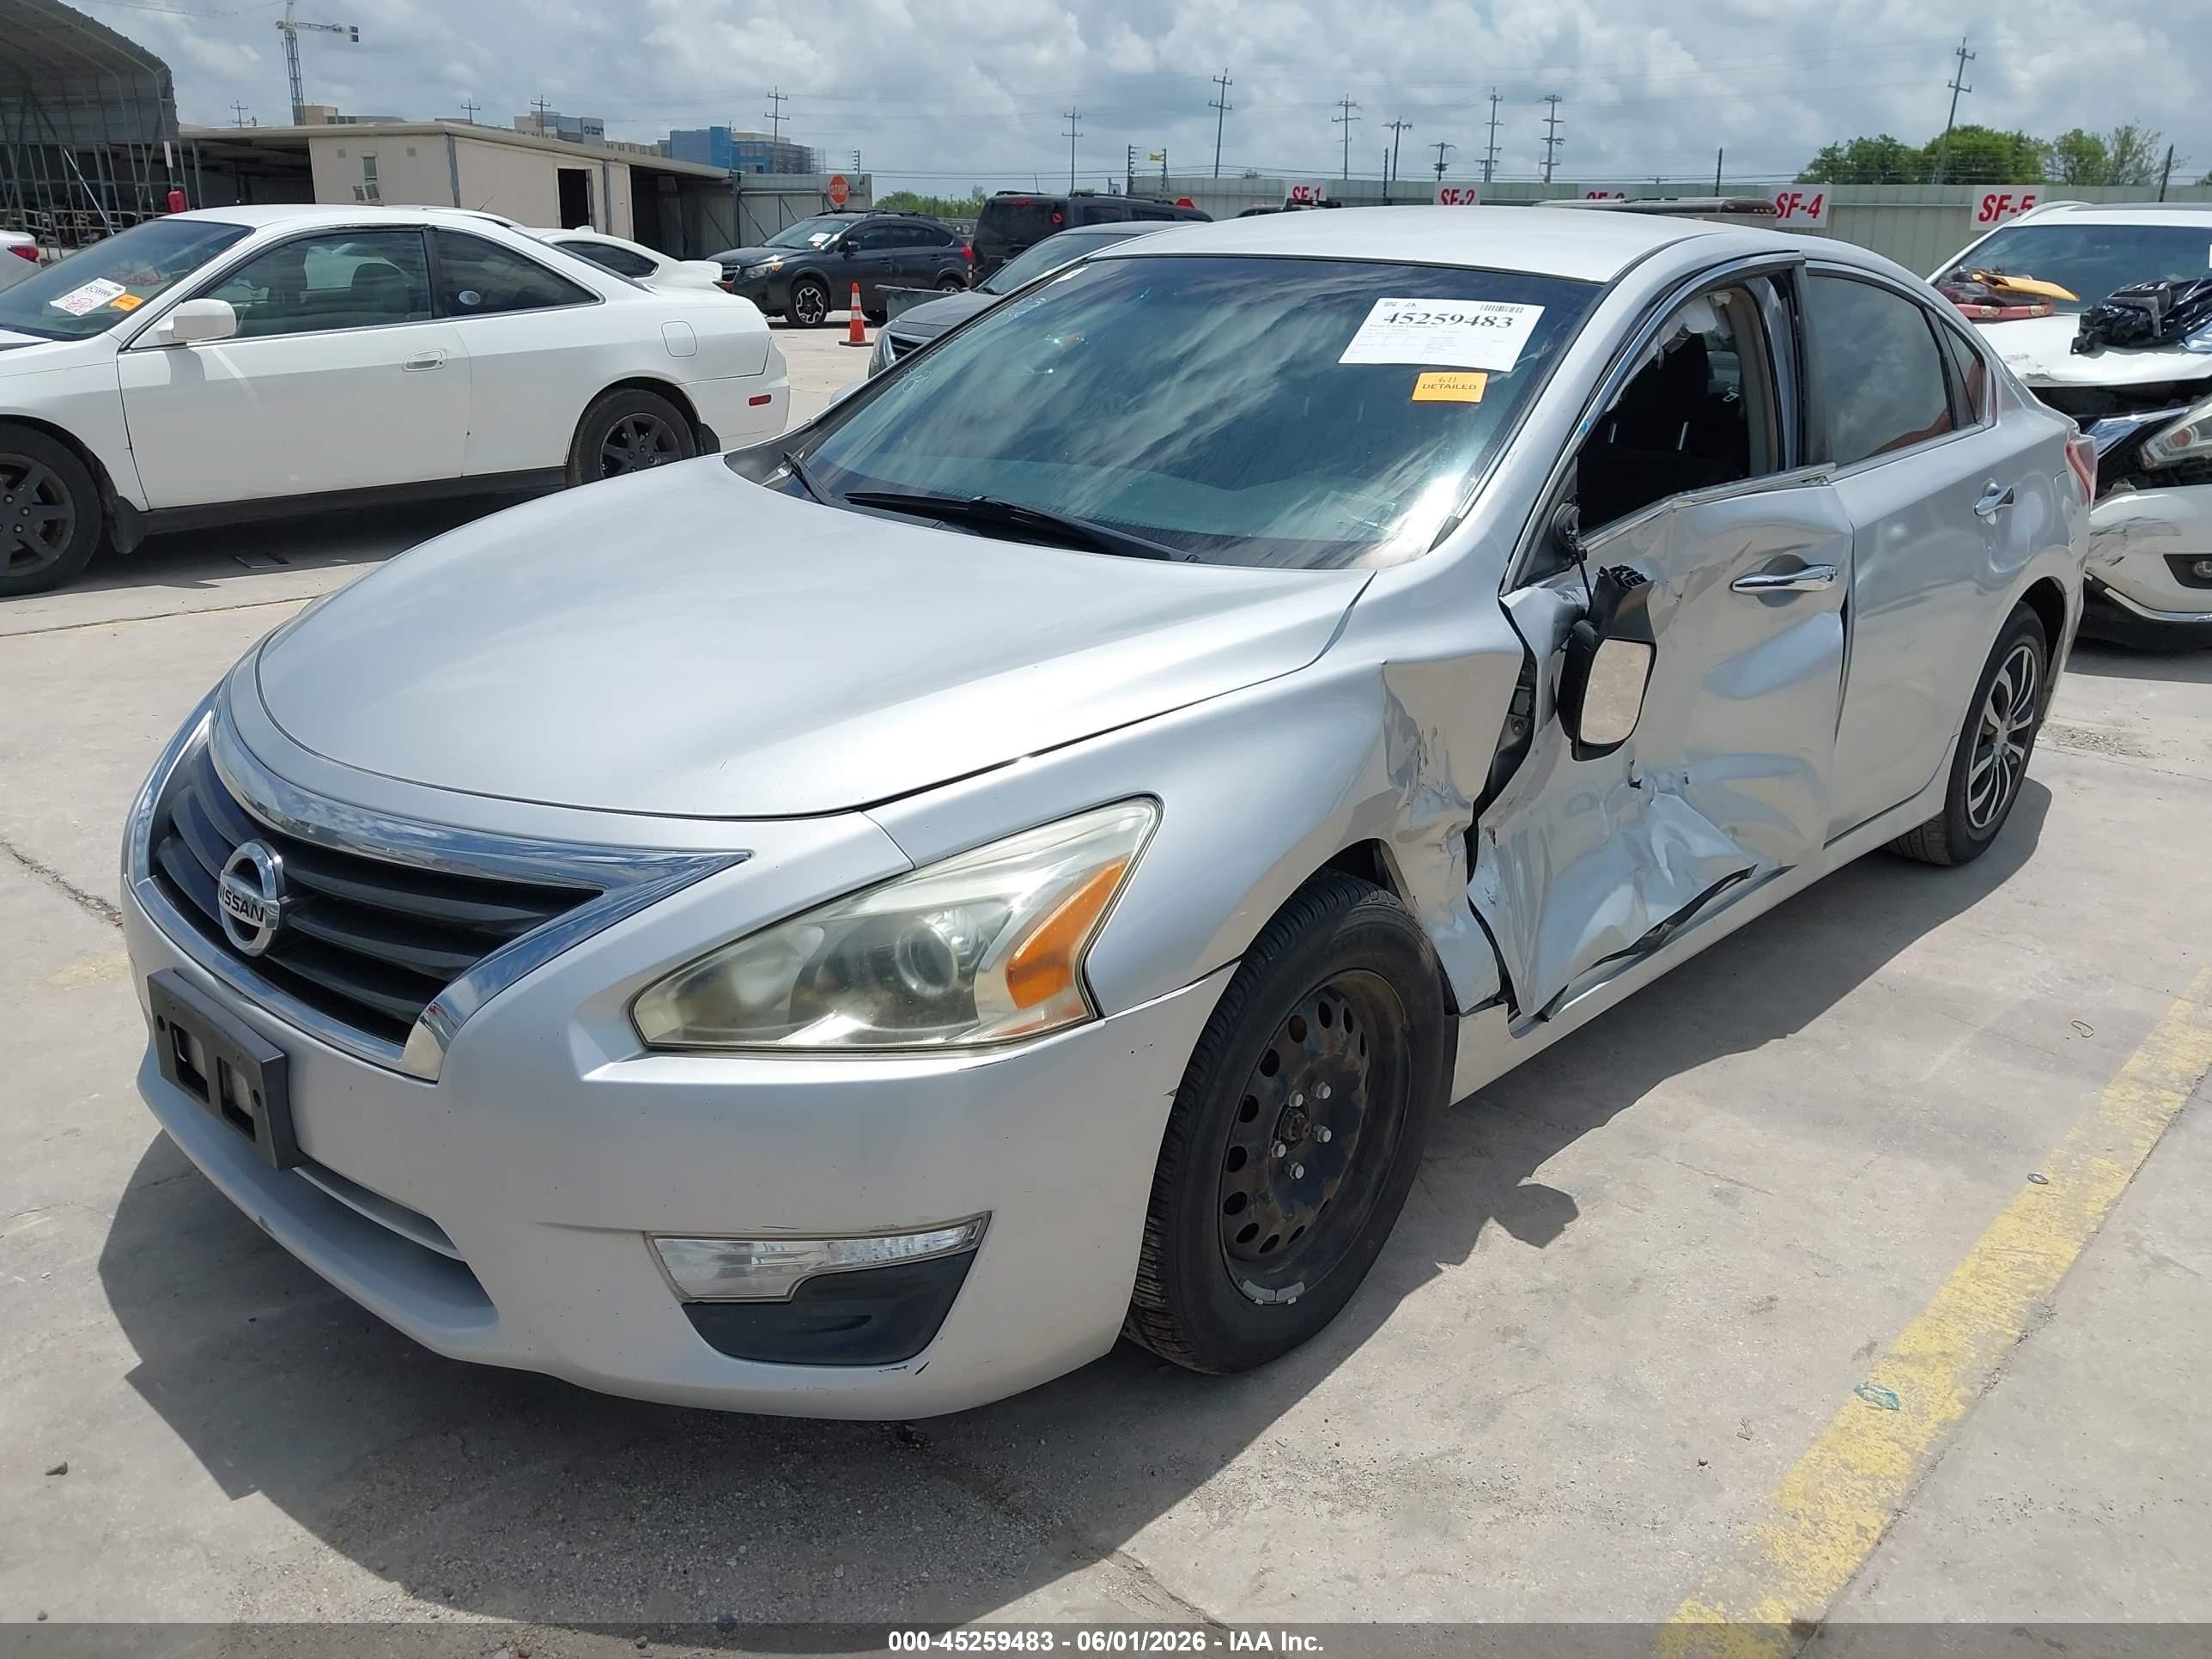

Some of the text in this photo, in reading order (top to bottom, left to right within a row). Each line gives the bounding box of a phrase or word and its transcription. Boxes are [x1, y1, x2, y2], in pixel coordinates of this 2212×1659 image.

[830, 185, 847, 196] STOP
[1441, 188, 1475, 205] SF-2
[1775, 192, 1824, 220] SF-4
[1978, 194, 2036, 222] SF-5
[1382, 312, 1514, 329] 45259483
